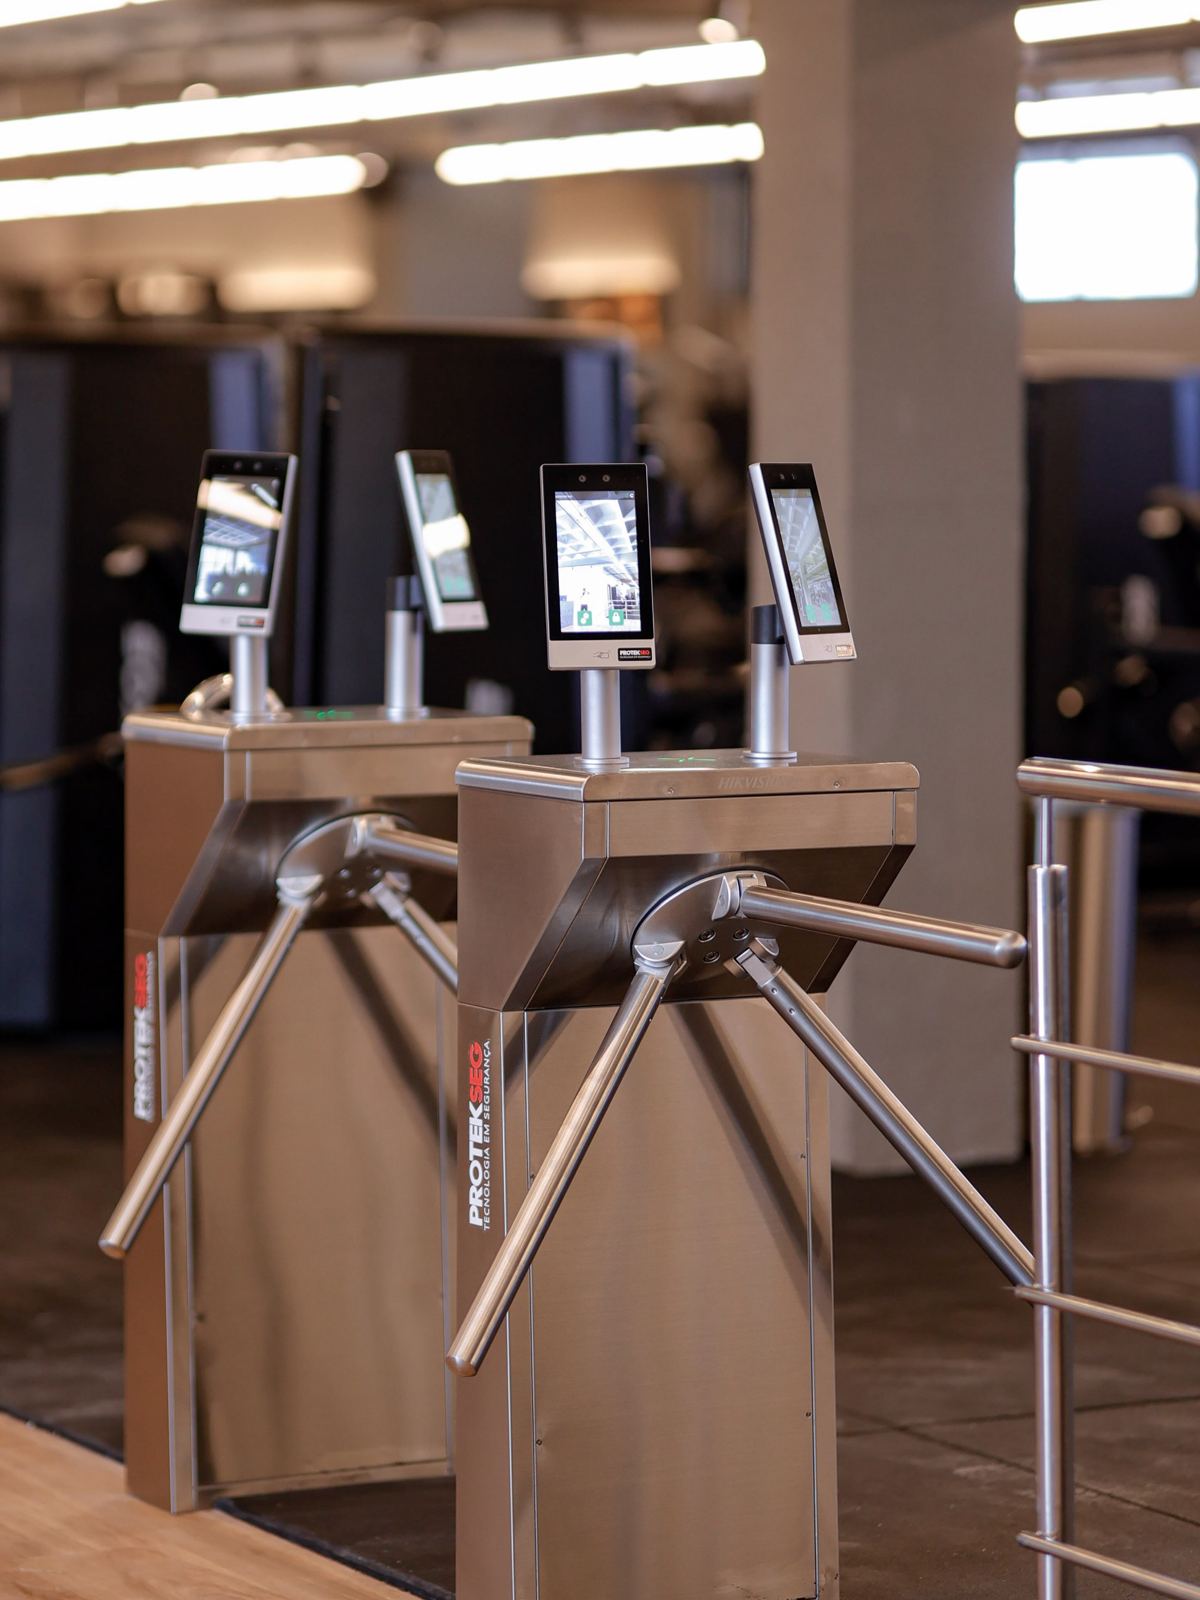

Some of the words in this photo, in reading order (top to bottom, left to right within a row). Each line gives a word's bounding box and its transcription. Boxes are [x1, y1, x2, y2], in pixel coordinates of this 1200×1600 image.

[718, 775, 786, 790] HIKVISI
[469, 1039, 483, 1227] PROTEKSEG
[484, 1124, 490, 1143] EM
